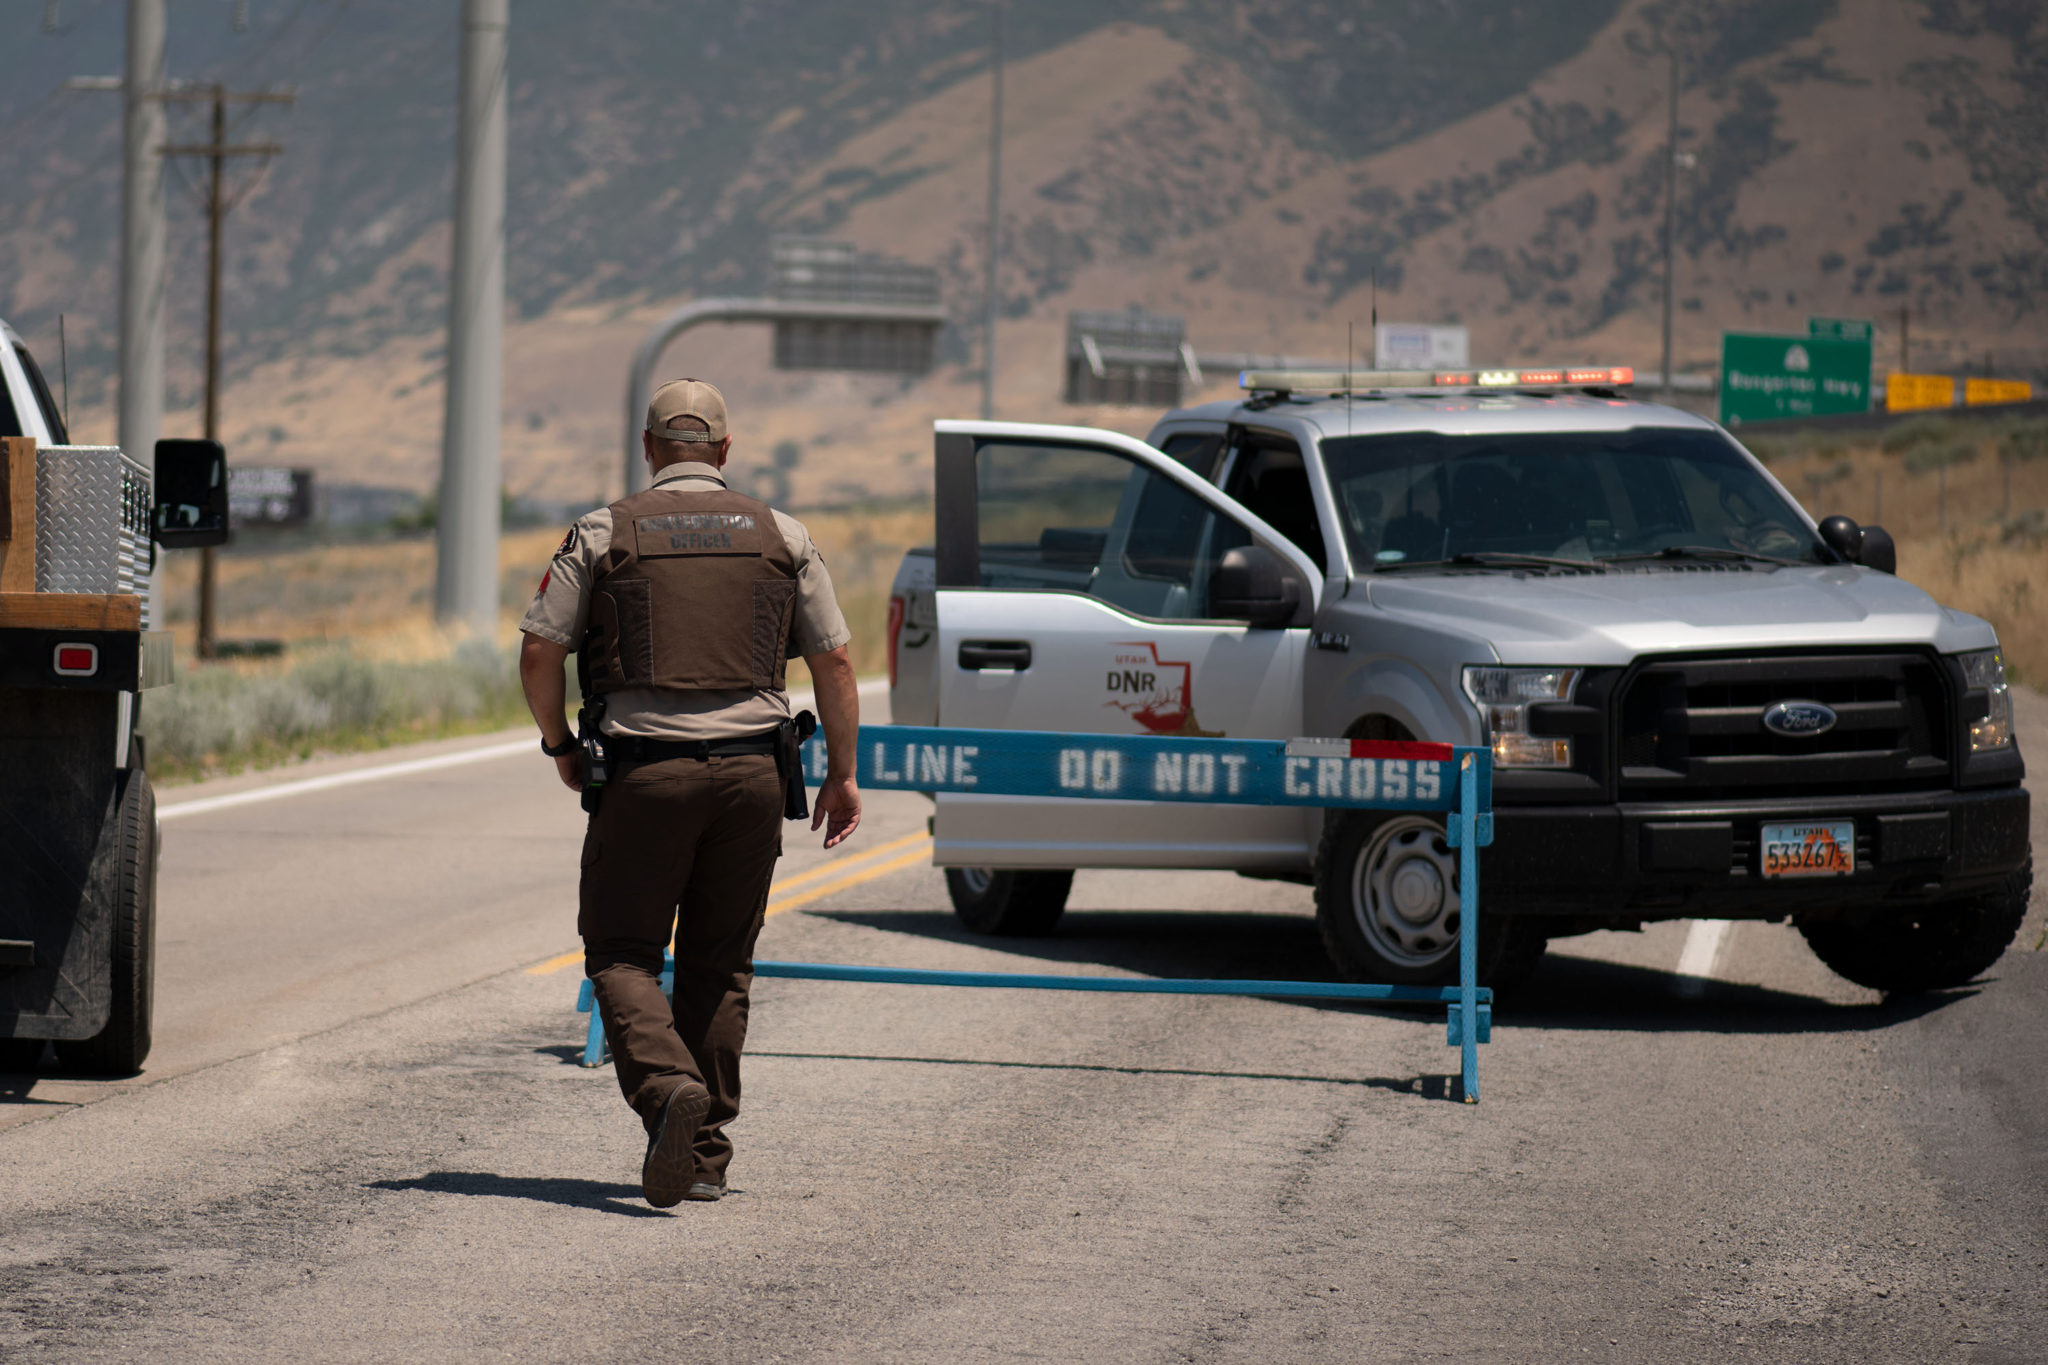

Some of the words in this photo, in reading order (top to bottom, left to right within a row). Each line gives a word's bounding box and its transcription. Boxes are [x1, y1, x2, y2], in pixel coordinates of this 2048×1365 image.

[639, 514, 756, 532] CONSERVATION
[670, 533, 732, 549] OFFICER
[1115, 655, 1147, 665] UTAH
[1106, 670, 1156, 693] DNR
[1782, 709, 1821, 729] Ford
[873, 742, 979, 785] LINE
[1059, 748, 1120, 791] DO
[1154, 752, 1247, 794] NOT
[1285, 757, 1440, 800] CROSS
[1793, 826, 1824, 837] UTAH
[1768, 842, 1835, 869] 533267
